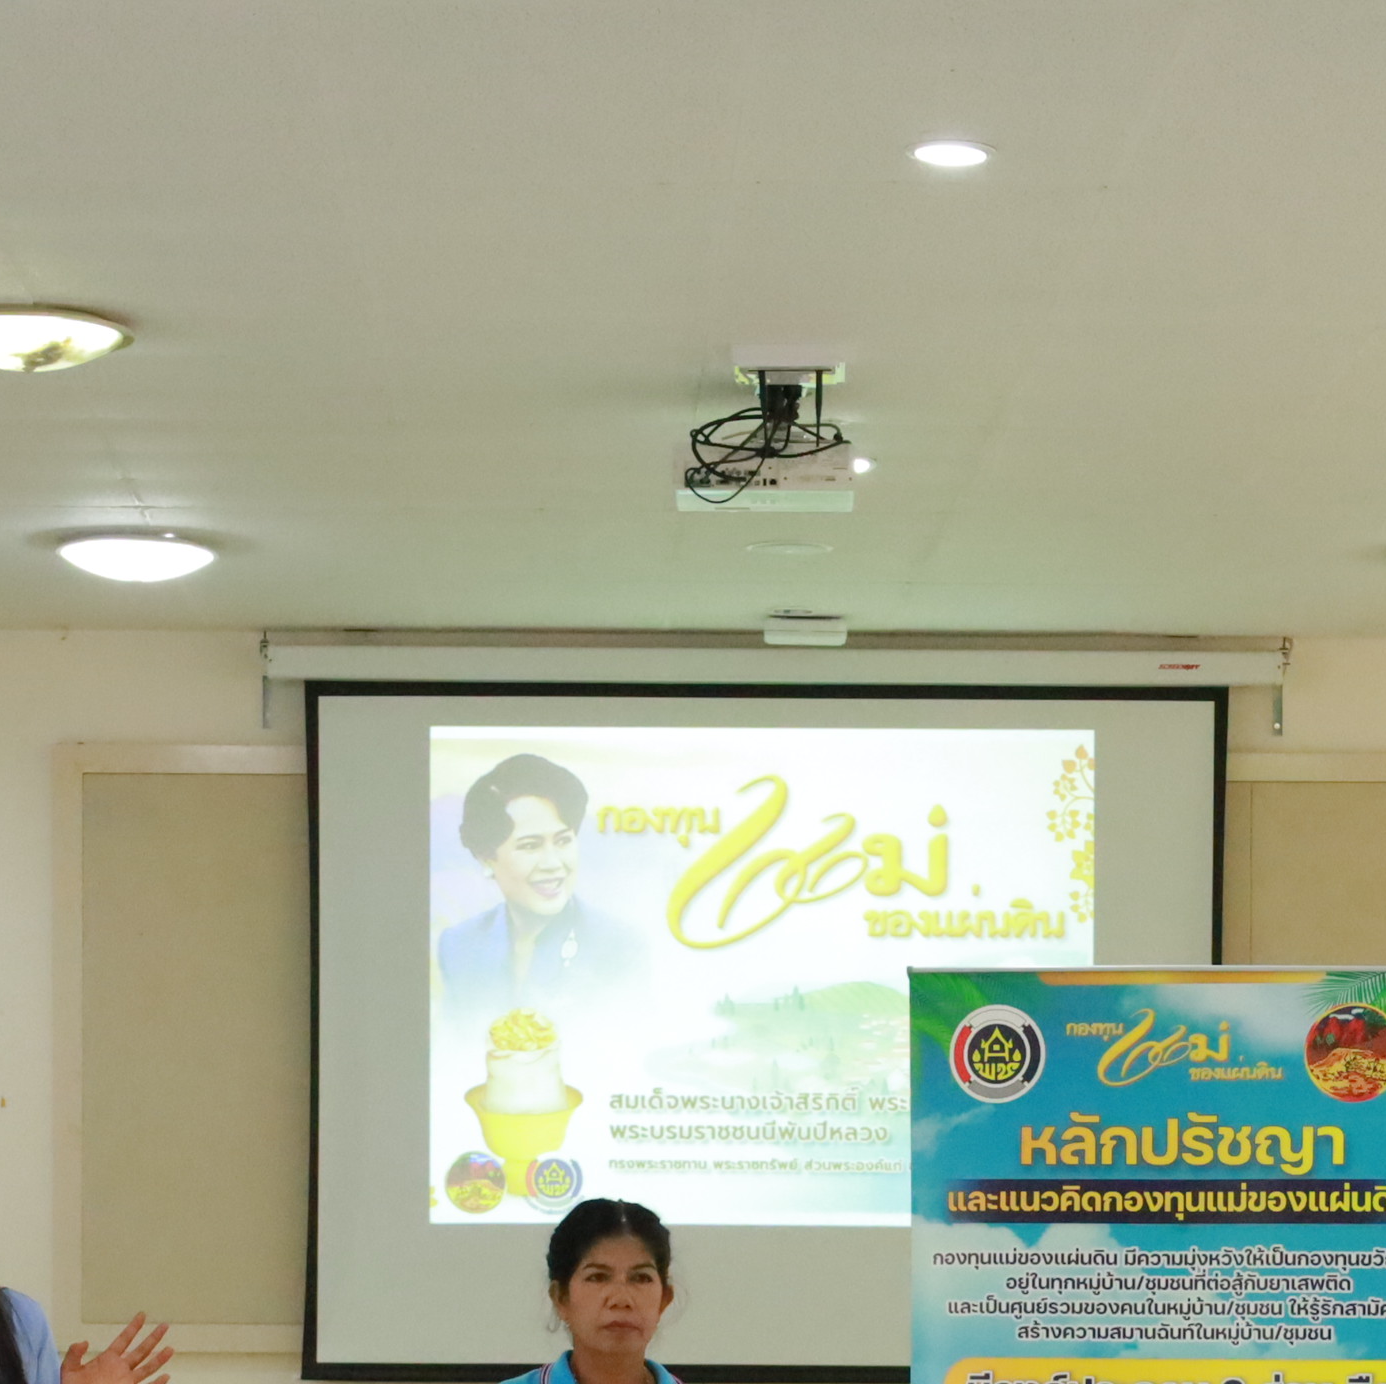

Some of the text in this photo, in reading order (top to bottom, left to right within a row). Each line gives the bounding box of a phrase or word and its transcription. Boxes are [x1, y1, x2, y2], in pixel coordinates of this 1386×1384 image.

[596, 805, 721, 847] กองทุน
[1066, 1021, 1124, 1043] กองทุน
[1019, 1111, 1346, 1176] หลักปรัชญา
[932, 1248, 1117, 1270] กองทุนแม่ของแผ่นดิน
[948, 1296, 1282, 1320] และเป็นศูนย์รวมของคนในหมู่บ้าน/ชุมชน
[1017, 1321, 1332, 1346] สร้างความสมานฉันท์ในหมู่บ้าน/ชุมชน
